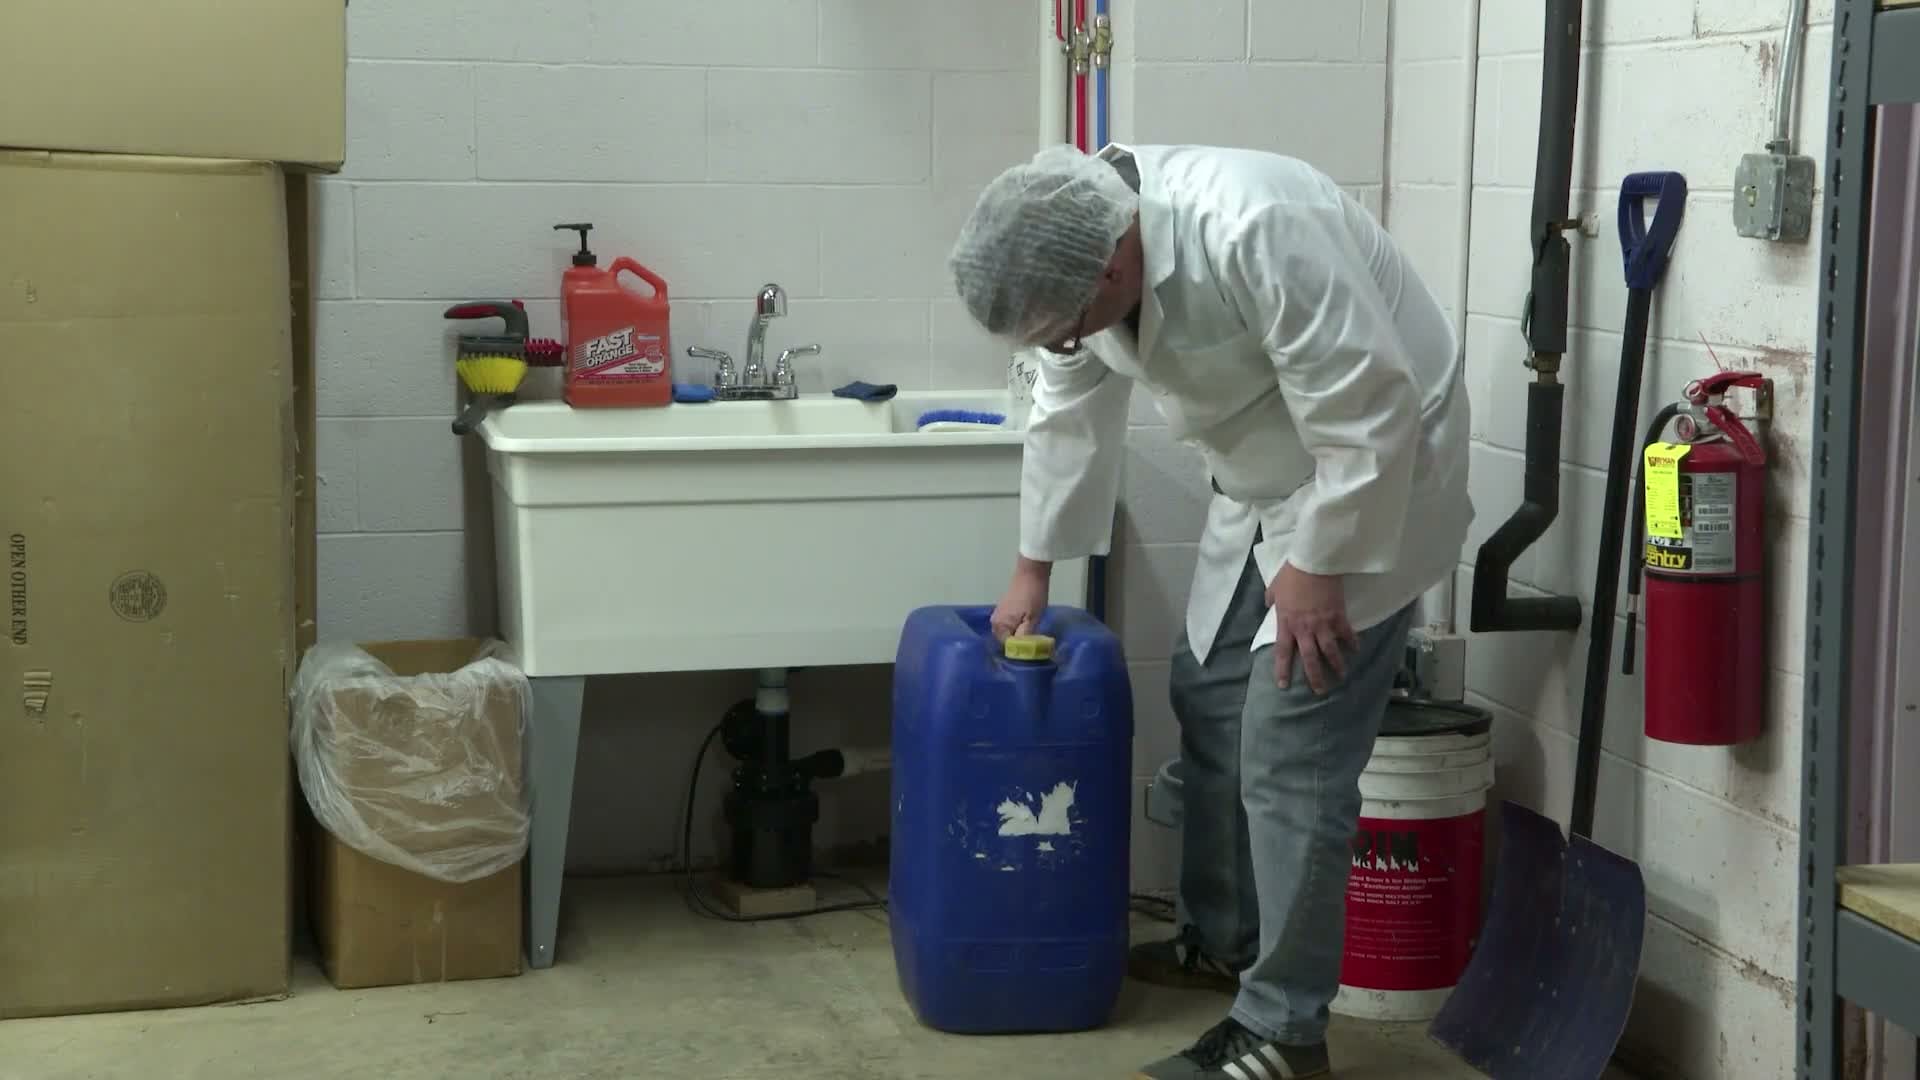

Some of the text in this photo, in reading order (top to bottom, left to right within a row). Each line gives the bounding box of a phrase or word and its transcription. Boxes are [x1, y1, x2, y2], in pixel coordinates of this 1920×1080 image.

[586, 327, 635, 358] FAST
[586, 344, 634, 367] ORANGE
[10, 533, 28, 646] OPEN OTHER END
